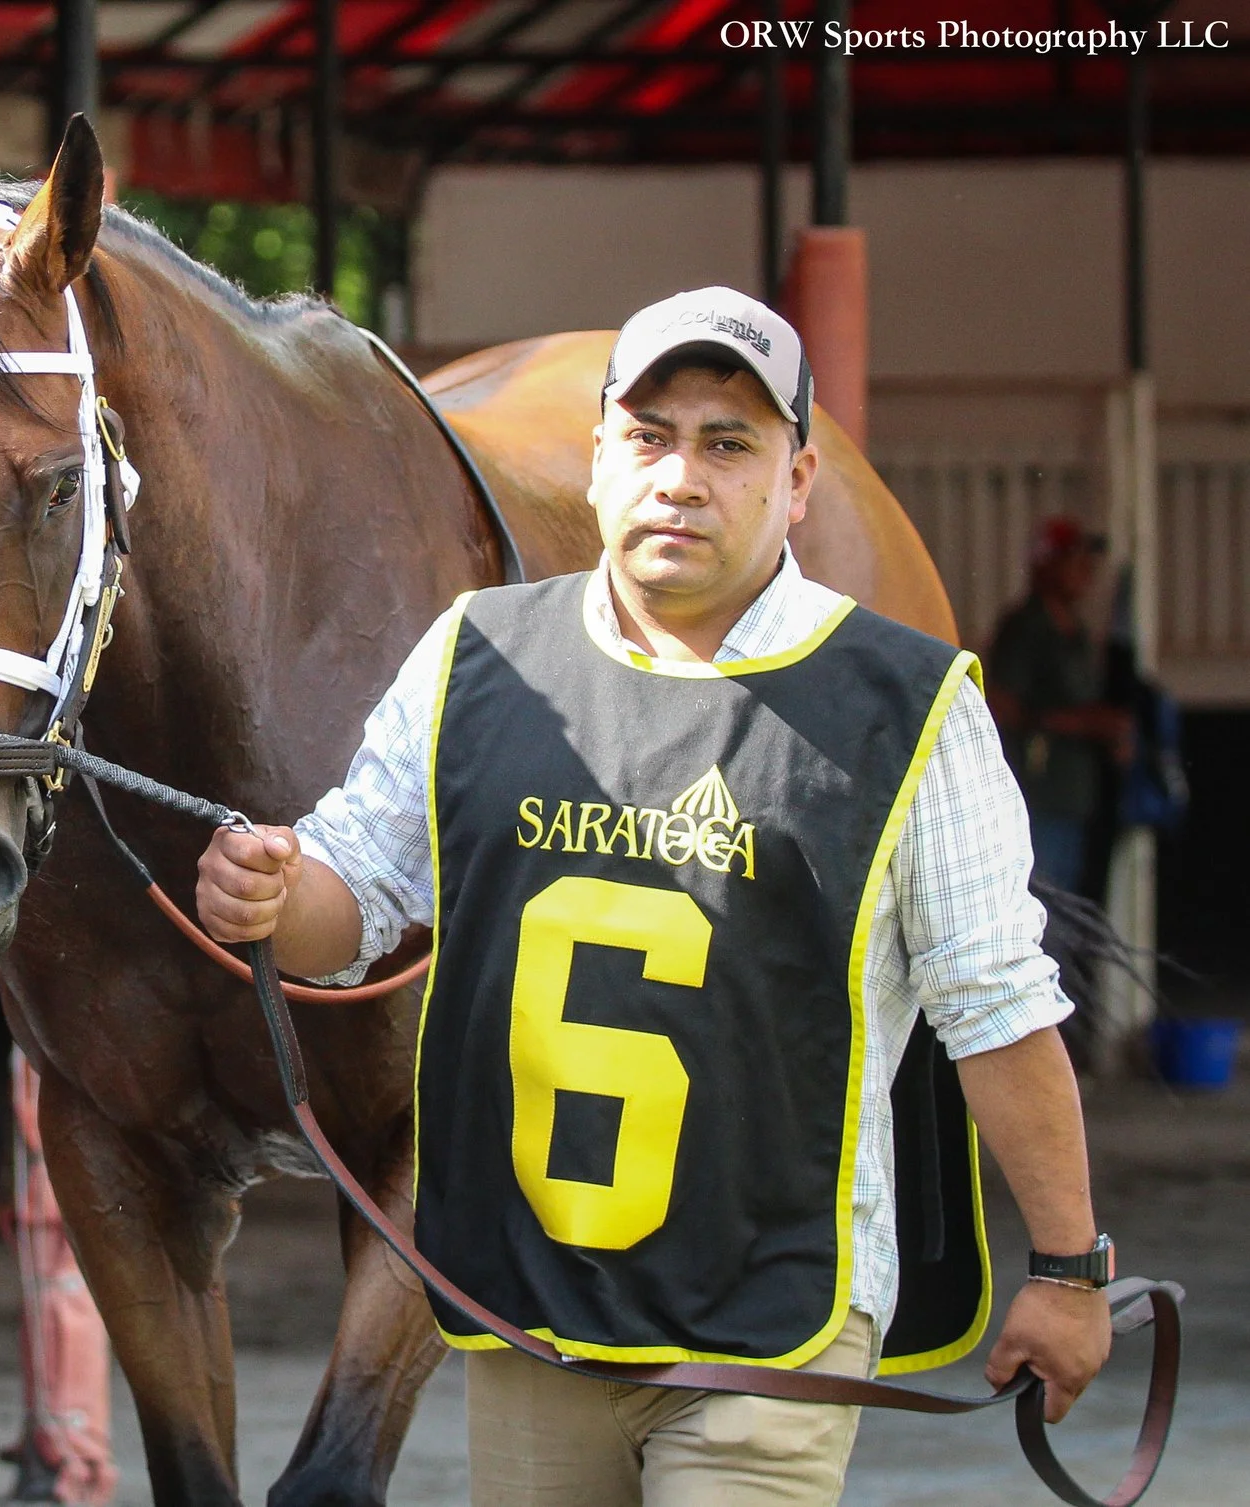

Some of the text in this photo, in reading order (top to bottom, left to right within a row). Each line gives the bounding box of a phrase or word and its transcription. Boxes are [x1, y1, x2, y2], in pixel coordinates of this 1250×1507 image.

[679, 310, 772, 351] Columbia
[517, 796, 755, 880] SARATOGA
[509, 876, 713, 1250] 6
